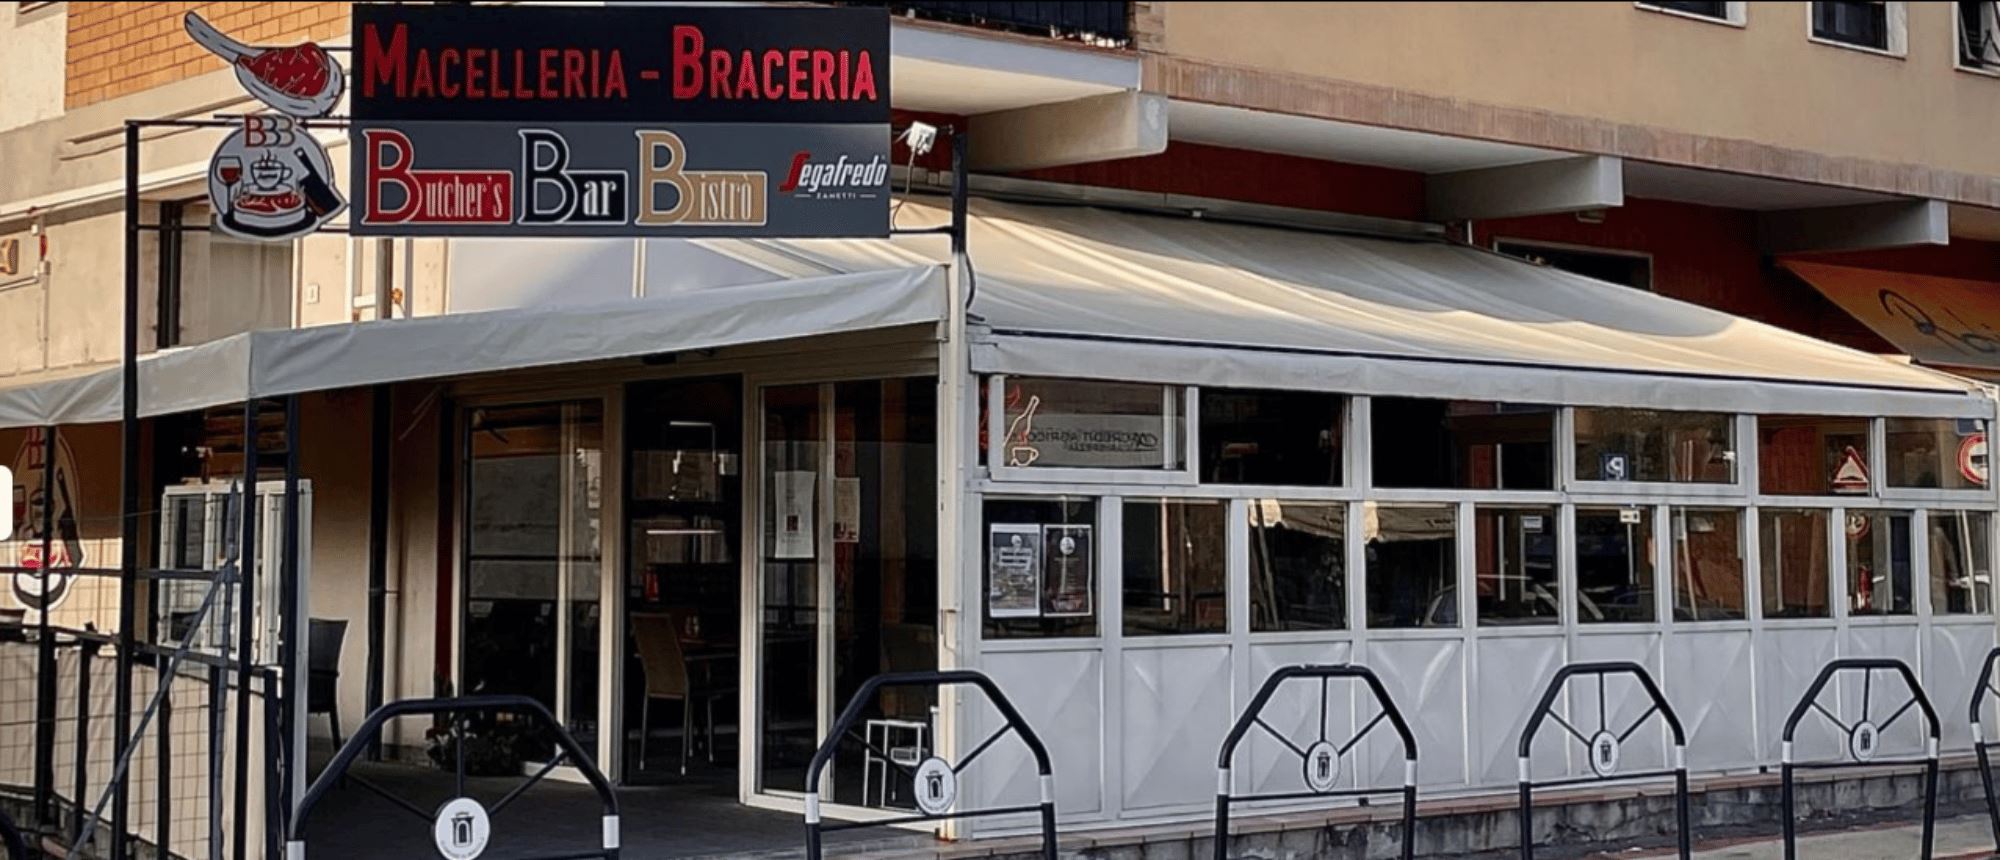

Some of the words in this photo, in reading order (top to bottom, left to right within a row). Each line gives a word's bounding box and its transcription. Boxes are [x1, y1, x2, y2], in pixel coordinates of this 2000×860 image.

[362, 23, 629, 99] MACELLERIA
[672, 25, 877, 101] BRACERIA
[361, 128, 503, 225] Butcher's
[517, 129, 617, 225] Bar
[634, 130, 752, 225] Bistrò
[778, 150, 888, 192] Segafredo
